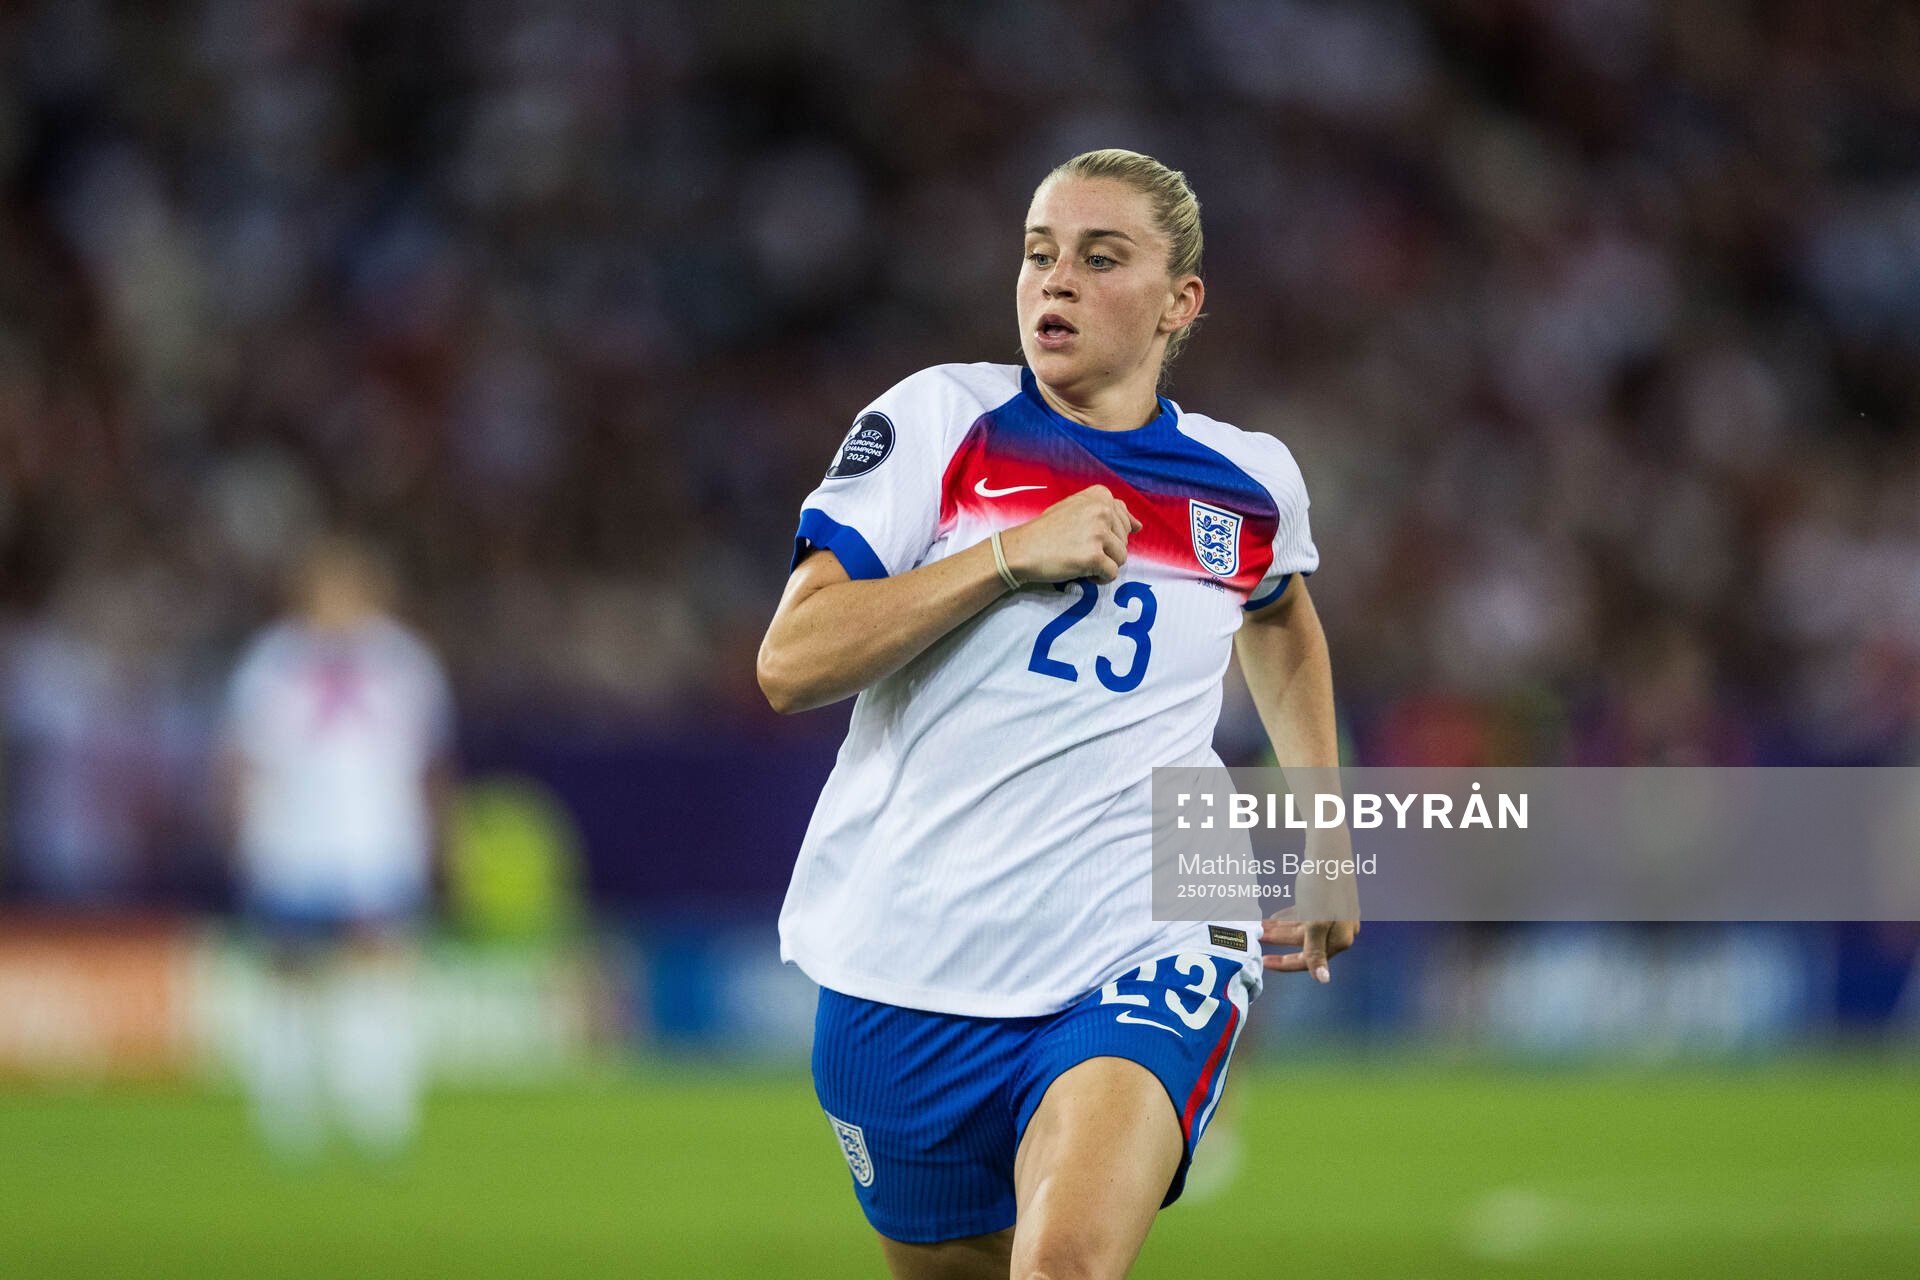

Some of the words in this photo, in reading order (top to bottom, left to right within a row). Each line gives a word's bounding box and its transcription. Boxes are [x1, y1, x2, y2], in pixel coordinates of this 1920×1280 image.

[846, 452, 870, 463] 2022
[1028, 577, 1158, 693] 23
[1100, 953, 1220, 1030] 23
